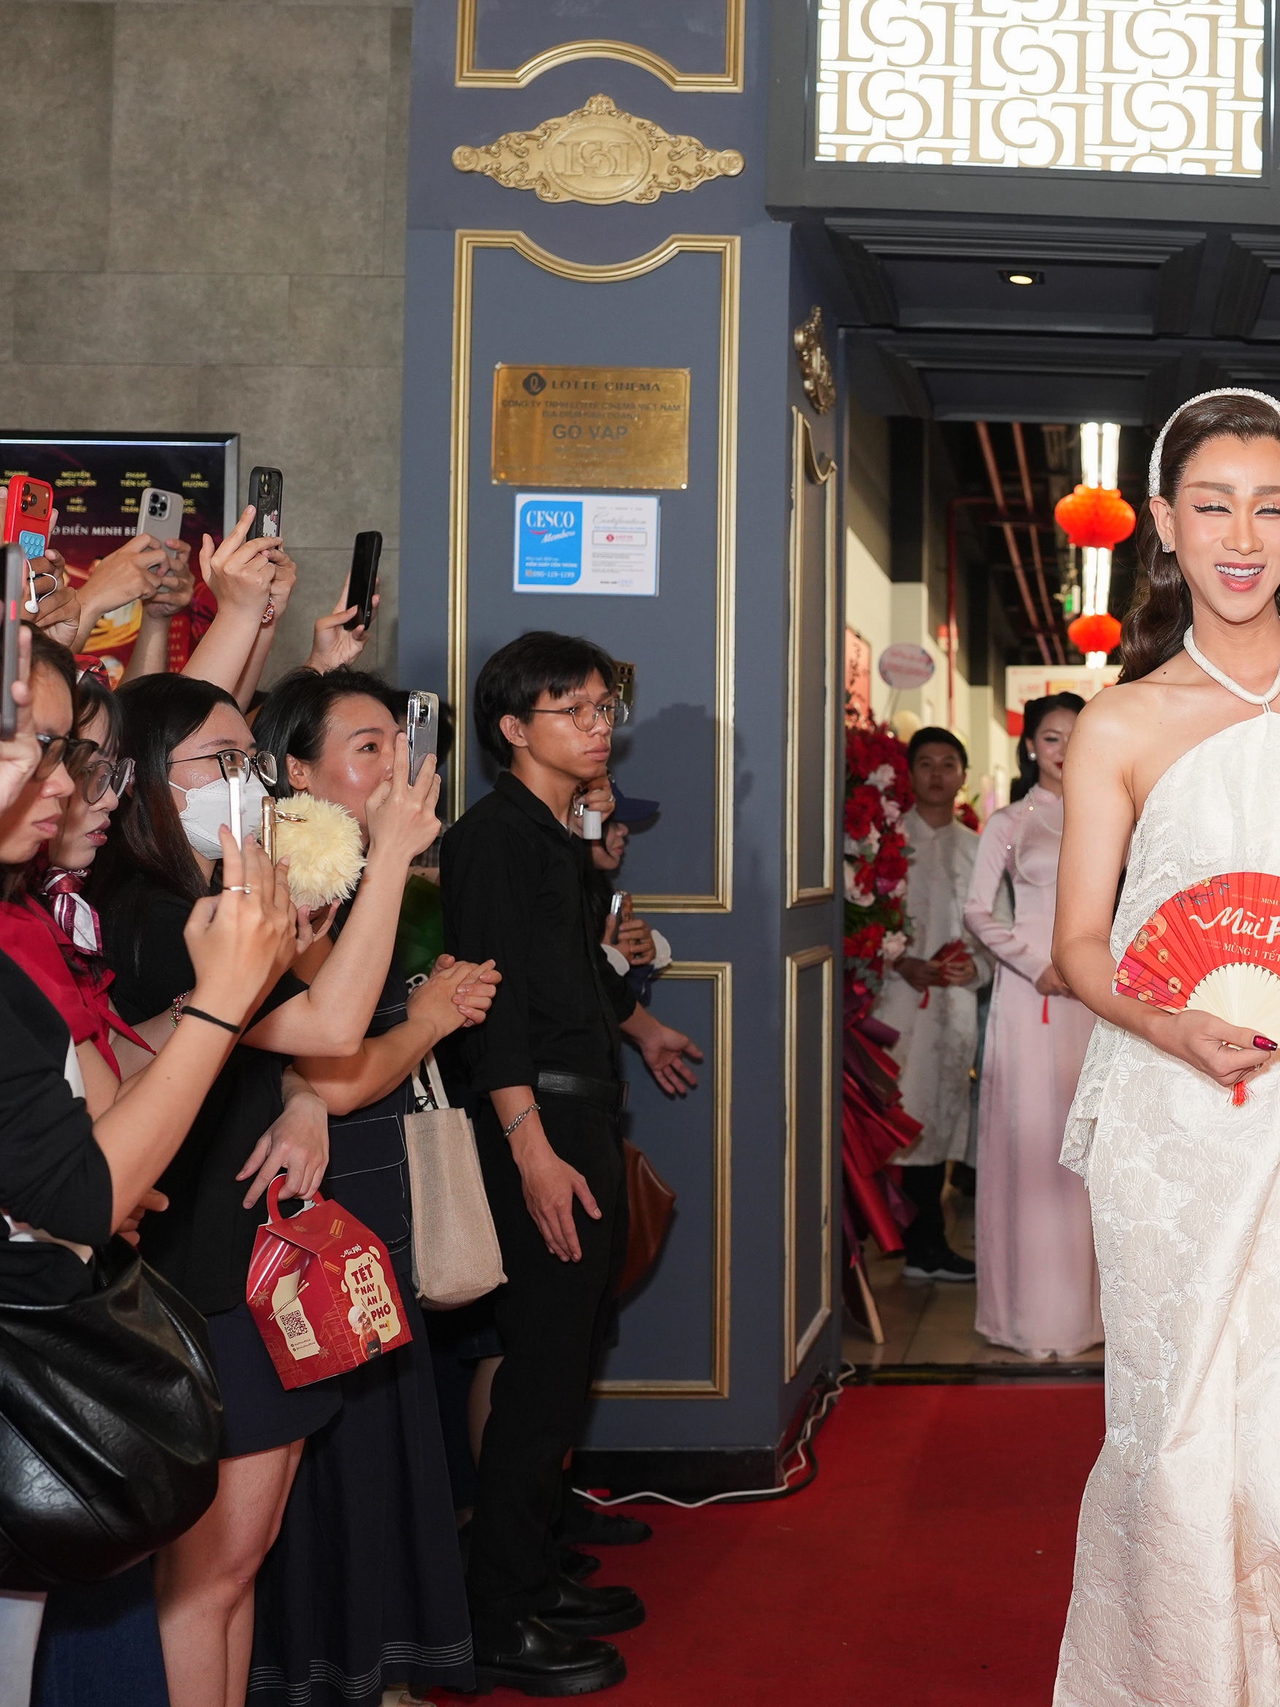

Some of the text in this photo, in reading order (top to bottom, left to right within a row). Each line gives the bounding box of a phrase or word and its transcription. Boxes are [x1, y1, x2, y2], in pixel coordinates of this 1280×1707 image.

[551, 381, 661, 392] LOTTE CINEMA
[526, 510, 575, 529] CESCO
[350, 1262, 374, 1286] TẾT
